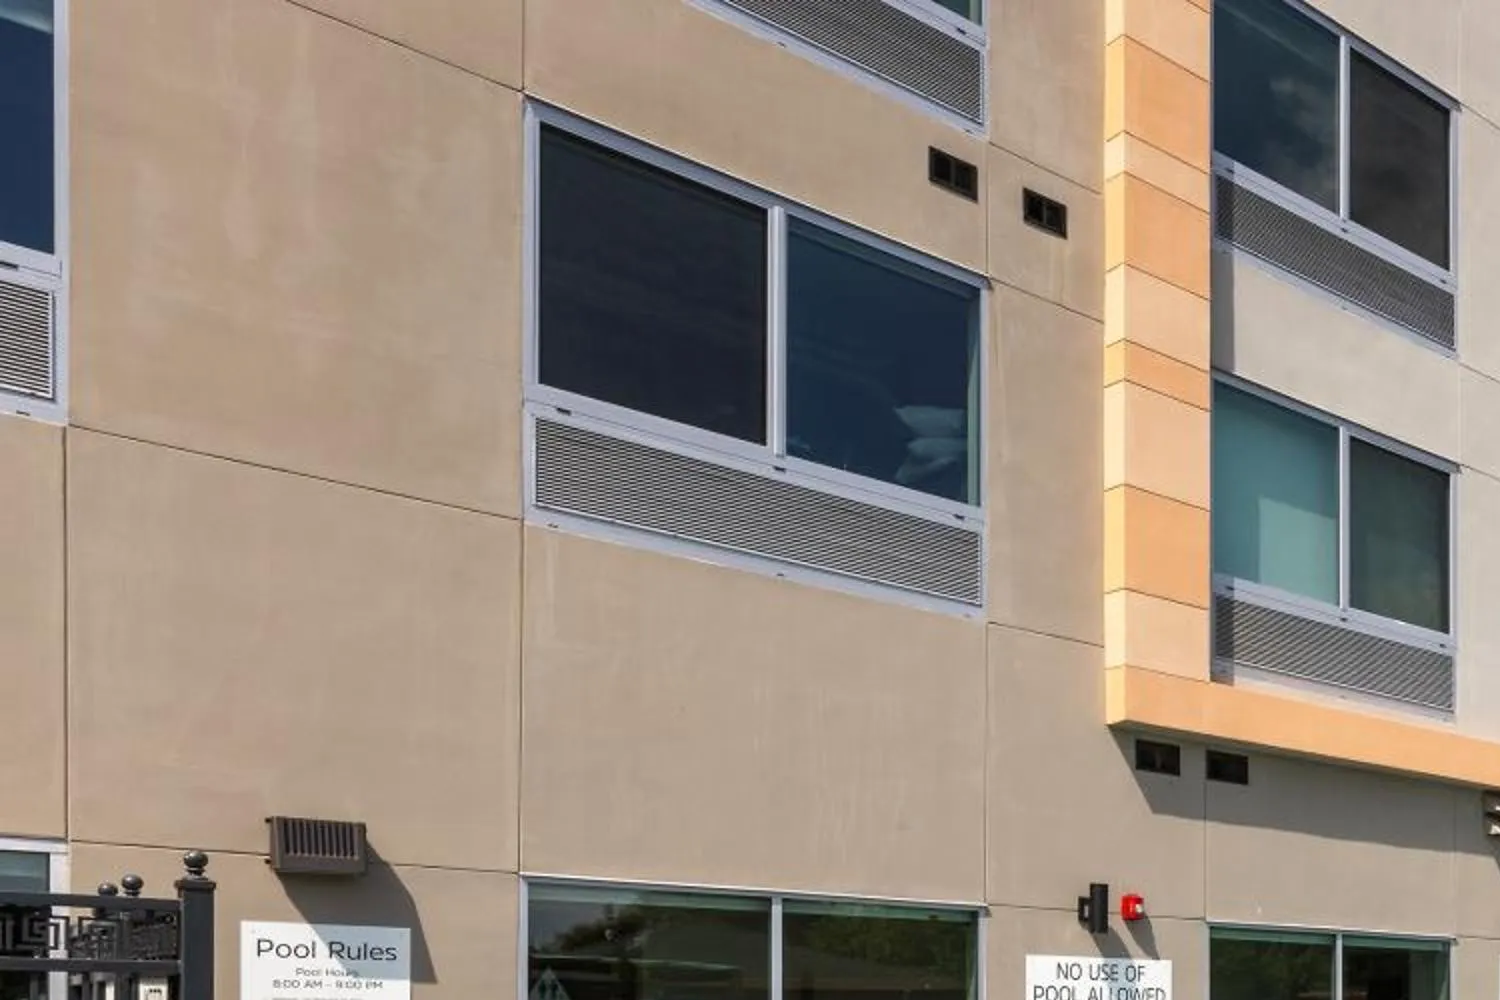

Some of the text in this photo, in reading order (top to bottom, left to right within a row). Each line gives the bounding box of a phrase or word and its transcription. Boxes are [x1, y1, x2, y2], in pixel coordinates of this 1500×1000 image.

[257, 939, 397, 961] Pool Rules
[296, 968, 359, 977] Pool Hours
[1056, 962, 1145, 982] NO USE OF
[273, 979, 300, 989] 8:00
[303, 980, 322, 989] AM
[366, 981, 383, 989] PM
